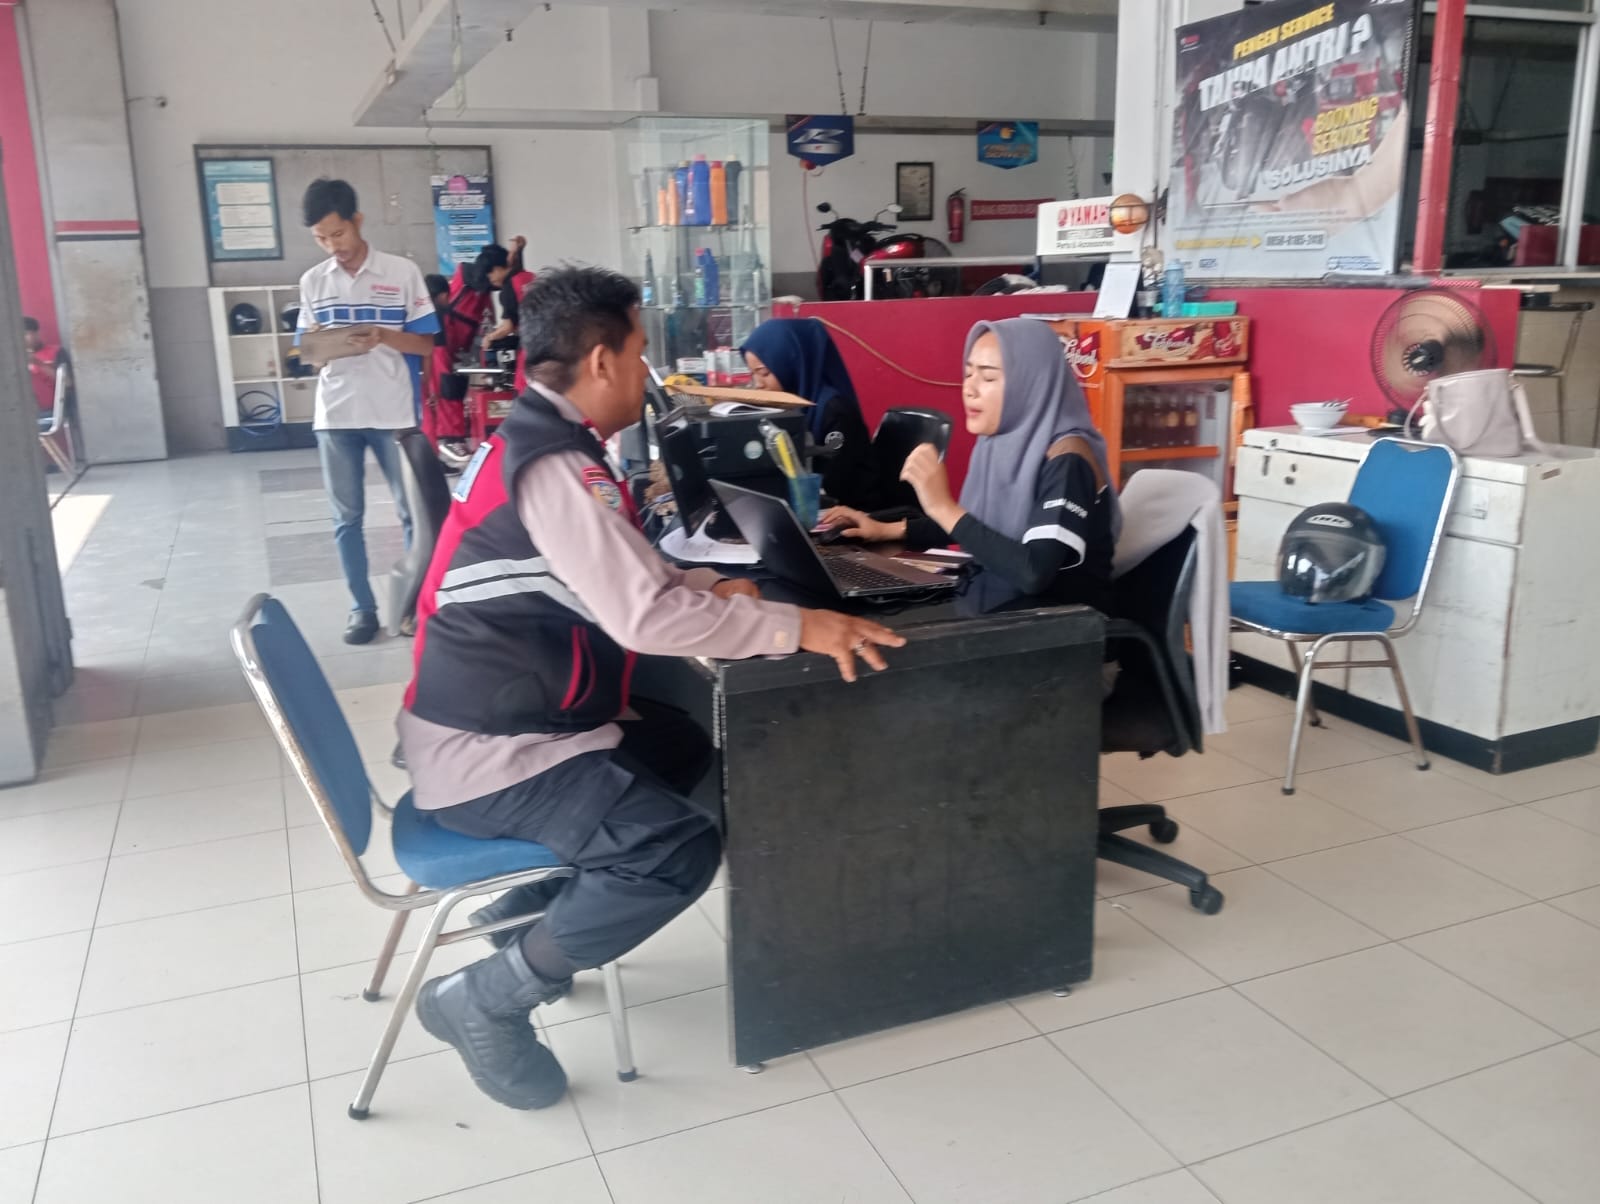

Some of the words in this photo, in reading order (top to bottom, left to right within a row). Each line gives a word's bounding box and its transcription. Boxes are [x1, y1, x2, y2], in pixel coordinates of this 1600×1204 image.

[1280, 2, 1335, 41] SERVICE
[1314, 96, 1379, 134] BOOKING
[1312, 120, 1371, 156] SERVICE
[1267, 144, 1373, 191] SOLUSINYA
